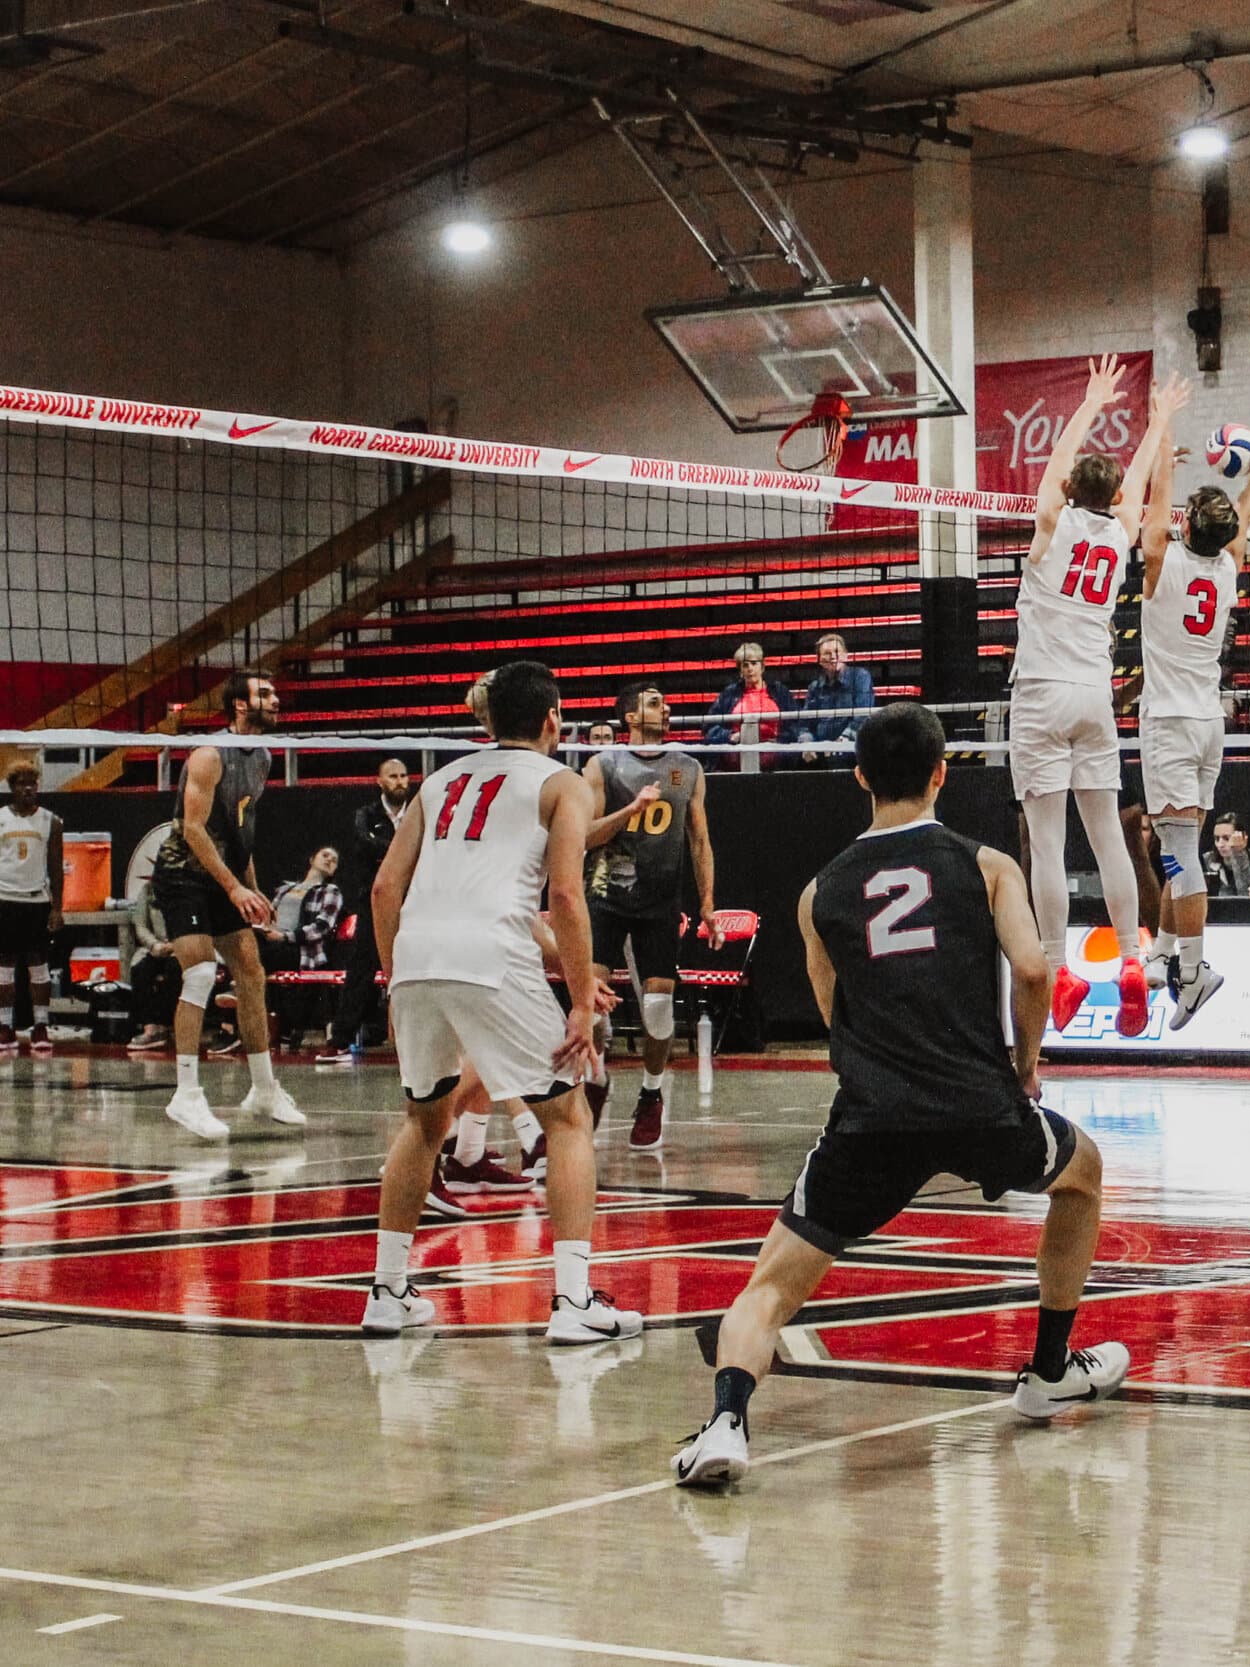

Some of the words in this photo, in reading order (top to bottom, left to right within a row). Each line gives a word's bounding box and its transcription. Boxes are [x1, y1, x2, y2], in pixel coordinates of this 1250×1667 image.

[98, 400, 201, 430] UNIVERSITY
[309, 426, 367, 450] NORTH
[367, 433, 457, 461] GREENVILLE
[459, 443, 541, 469] UNIVERSITY
[630, 459, 674, 481] NORTH
[678, 464, 750, 487] GREENVILLE
[895, 485, 932, 505] NORTH
[934, 489, 994, 511] GREENVILLE
[1060, 540, 1118, 605] 10
[1183, 577, 1218, 637] 3
[435, 772, 508, 842] 11
[626, 799, 673, 836] 10
[863, 865, 937, 960] 2
